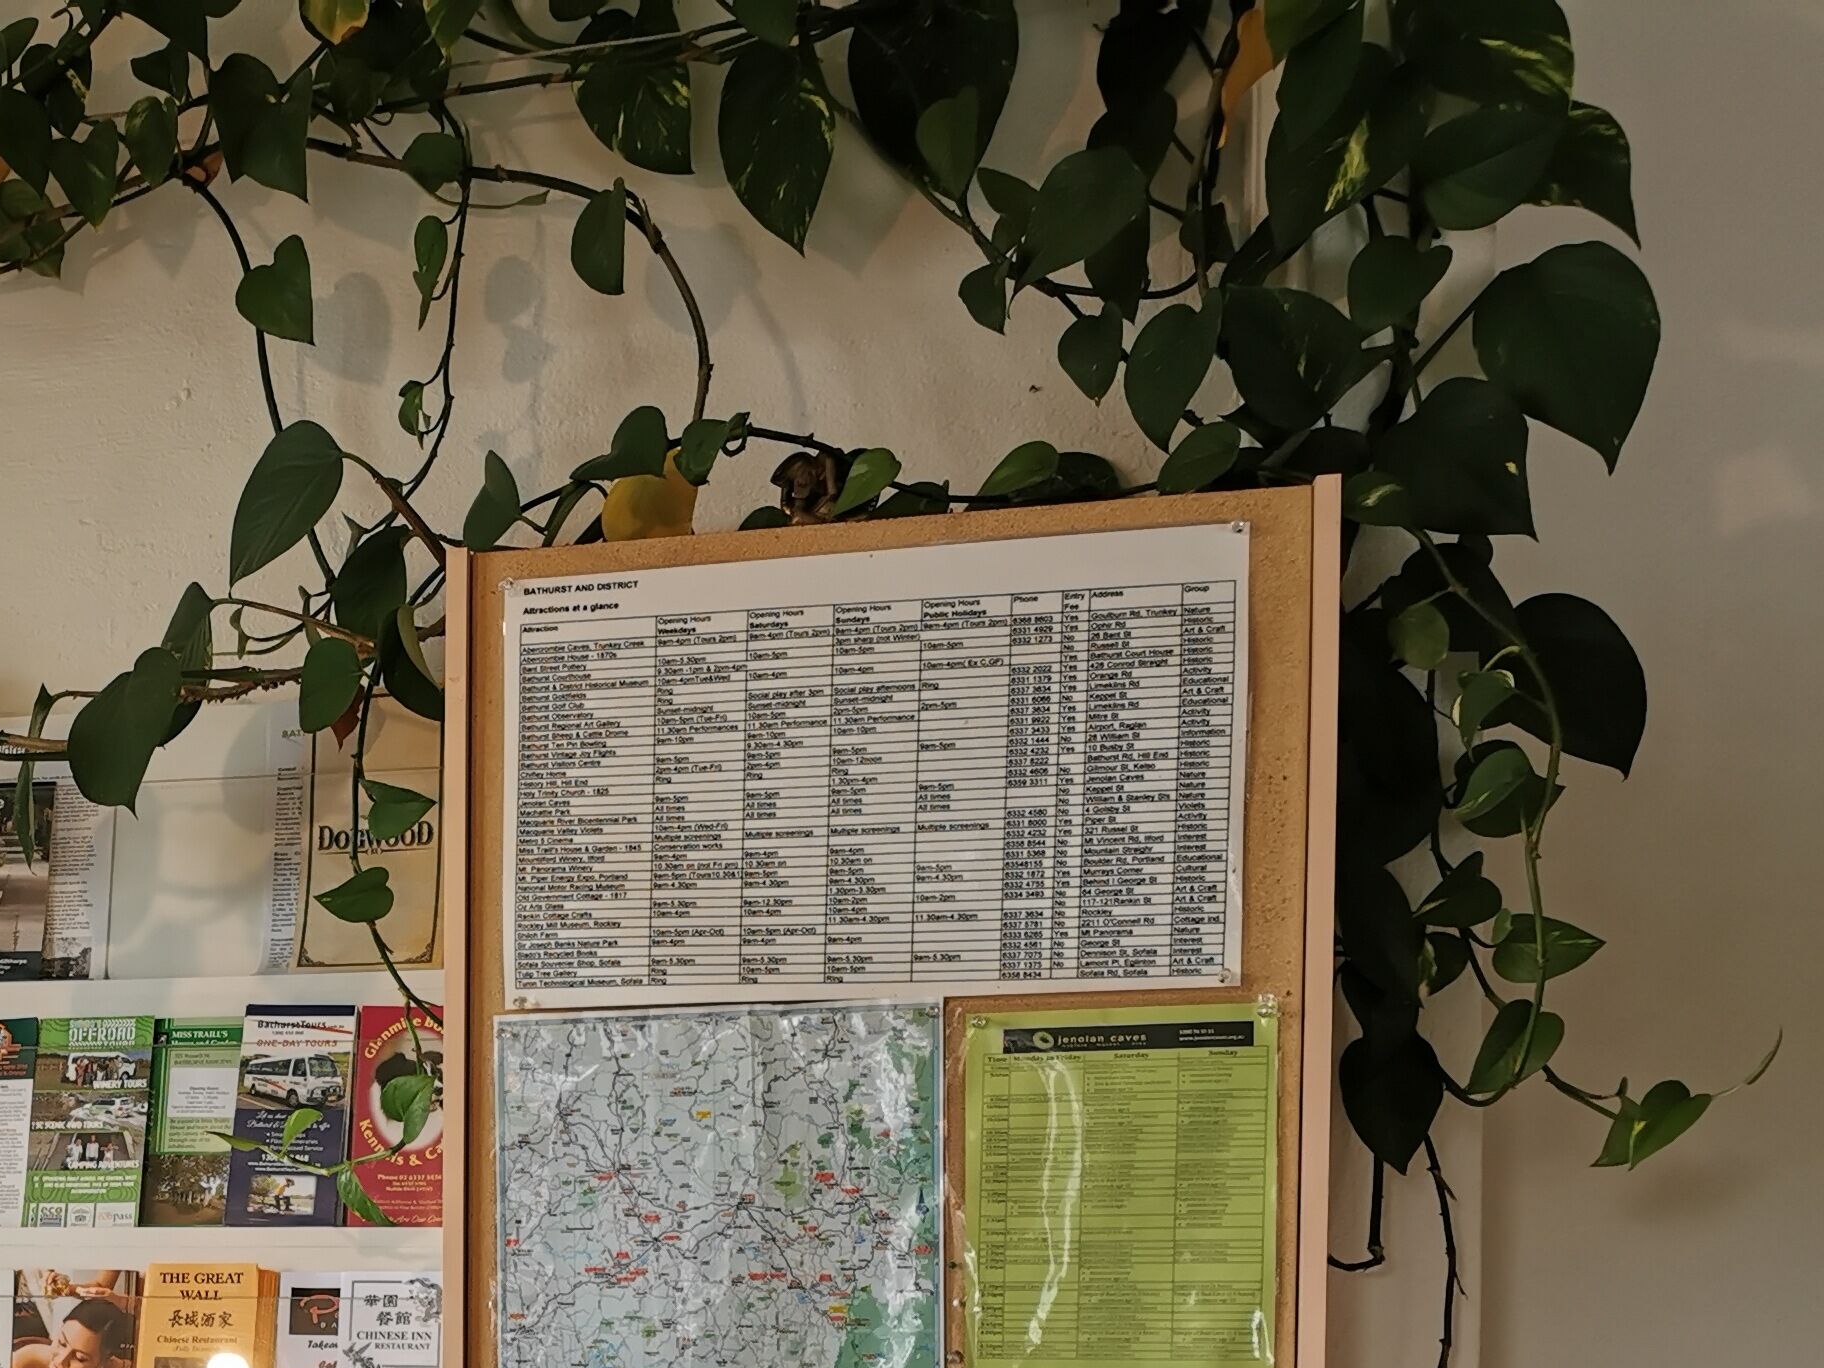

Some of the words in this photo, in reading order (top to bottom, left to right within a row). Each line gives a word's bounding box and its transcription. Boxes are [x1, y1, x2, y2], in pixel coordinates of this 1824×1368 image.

[524, 584, 573, 596] BATHURST
[575, 583, 594, 593] AND
[596, 580, 639, 591] DISTRICT
[523, 605, 570, 615] Attractions
[590, 602, 620, 613] glance
[172, 1031, 189, 1039] MISS
[190, 1030, 229, 1038] TRAILL'S
[1057, 1035, 1104, 1045] jenolan
[1110, 1034, 1147, 1042] caves
[256, 1039, 302, 1048] ONE-DAY
[305, 1039, 338, 1047] TOURS
[160, 1272, 190, 1284] THE
[194, 1272, 244, 1284] GREAT
[180, 1289, 222, 1300] WALL
[357, 1331, 408, 1340] CHINESE
[411, 1332, 433, 1340] INN
